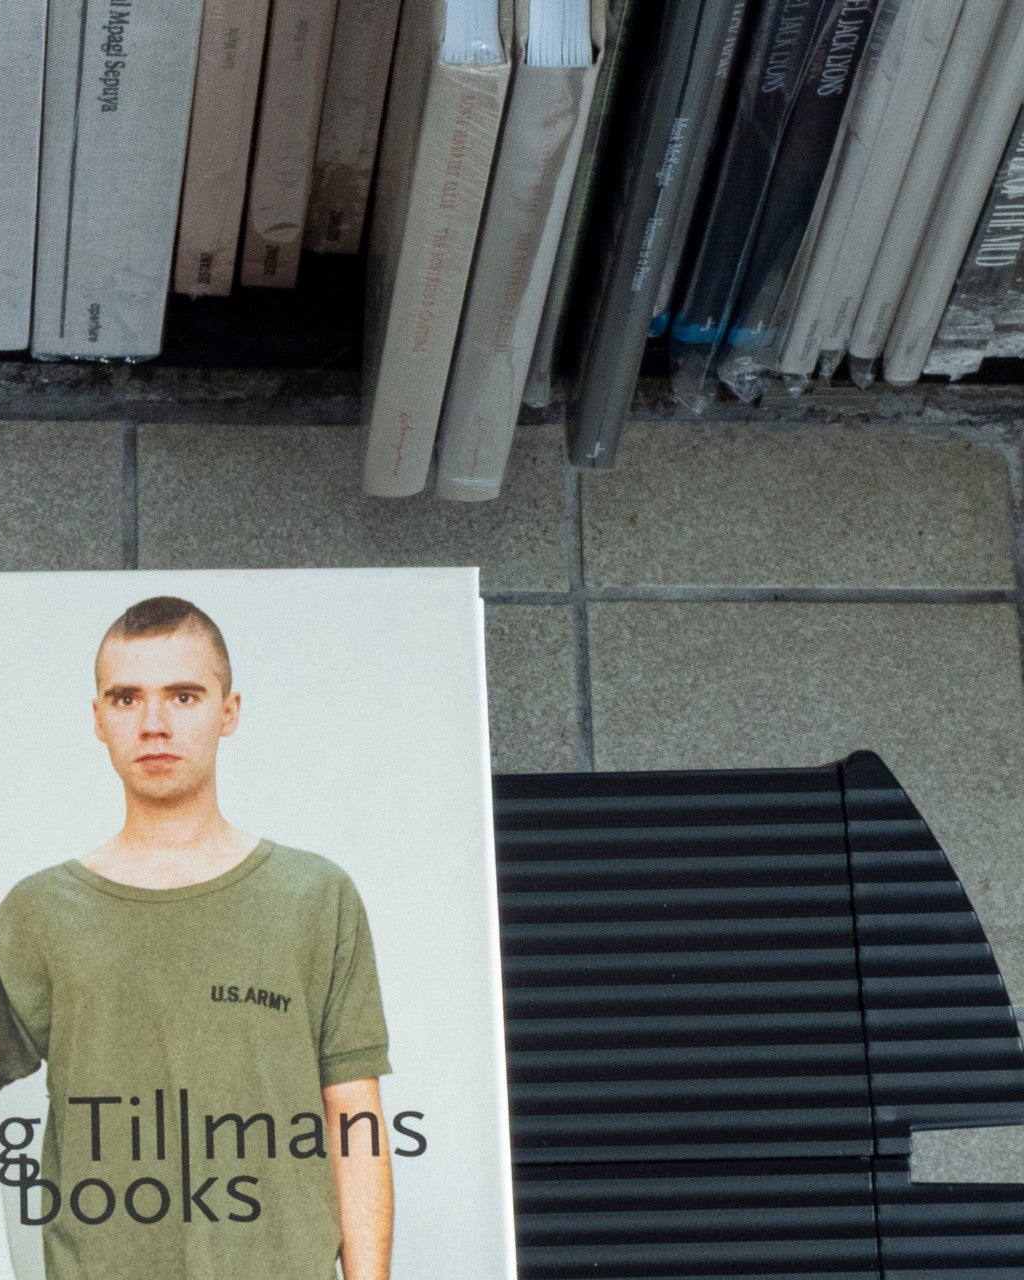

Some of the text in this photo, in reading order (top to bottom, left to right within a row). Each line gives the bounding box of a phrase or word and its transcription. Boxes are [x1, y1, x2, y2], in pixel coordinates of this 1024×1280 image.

[101, 12, 131, 57] Mpagi
[776, 16, 806, 49] JACK
[830, 18, 864, 52] JACK
[98, 60, 127, 113] Sepuya
[761, 52, 791, 93] LYONS
[817, 54, 853, 96] LYONS
[68, 1088, 429, 1160] Tillmans
[19, 1153, 262, 1228] books
